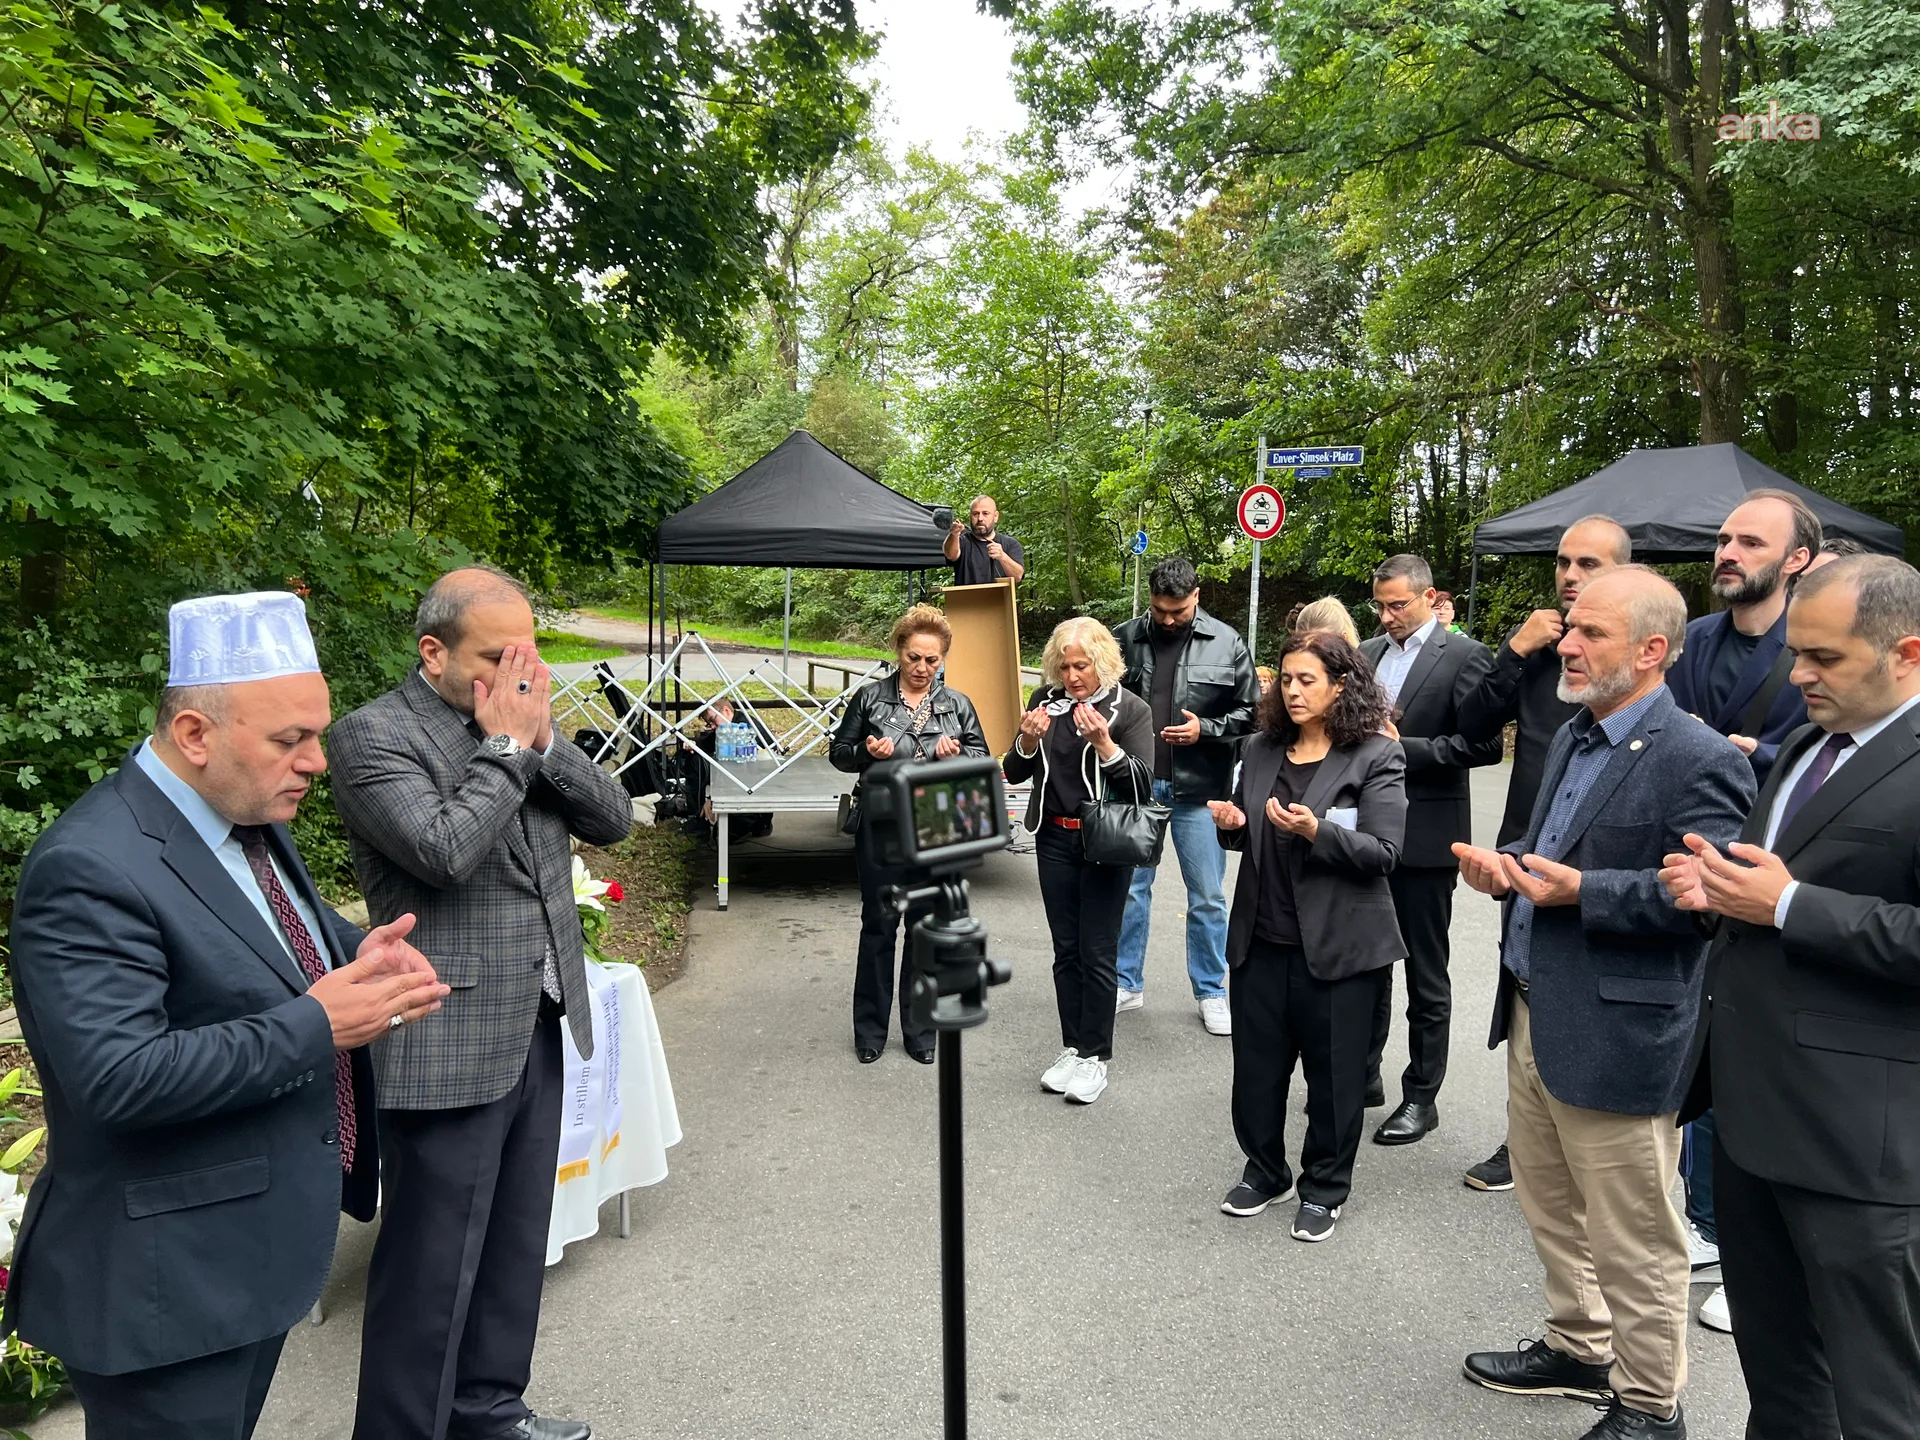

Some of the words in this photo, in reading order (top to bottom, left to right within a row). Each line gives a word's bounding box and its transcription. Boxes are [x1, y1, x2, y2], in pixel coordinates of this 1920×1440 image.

[1273, 451, 1354, 464] Enver-Şimşek-Platz
[610, 981, 619, 1030] Türkiye
[575, 1066, 590, 1109] stillem
[573, 1113, 585, 1127] In
